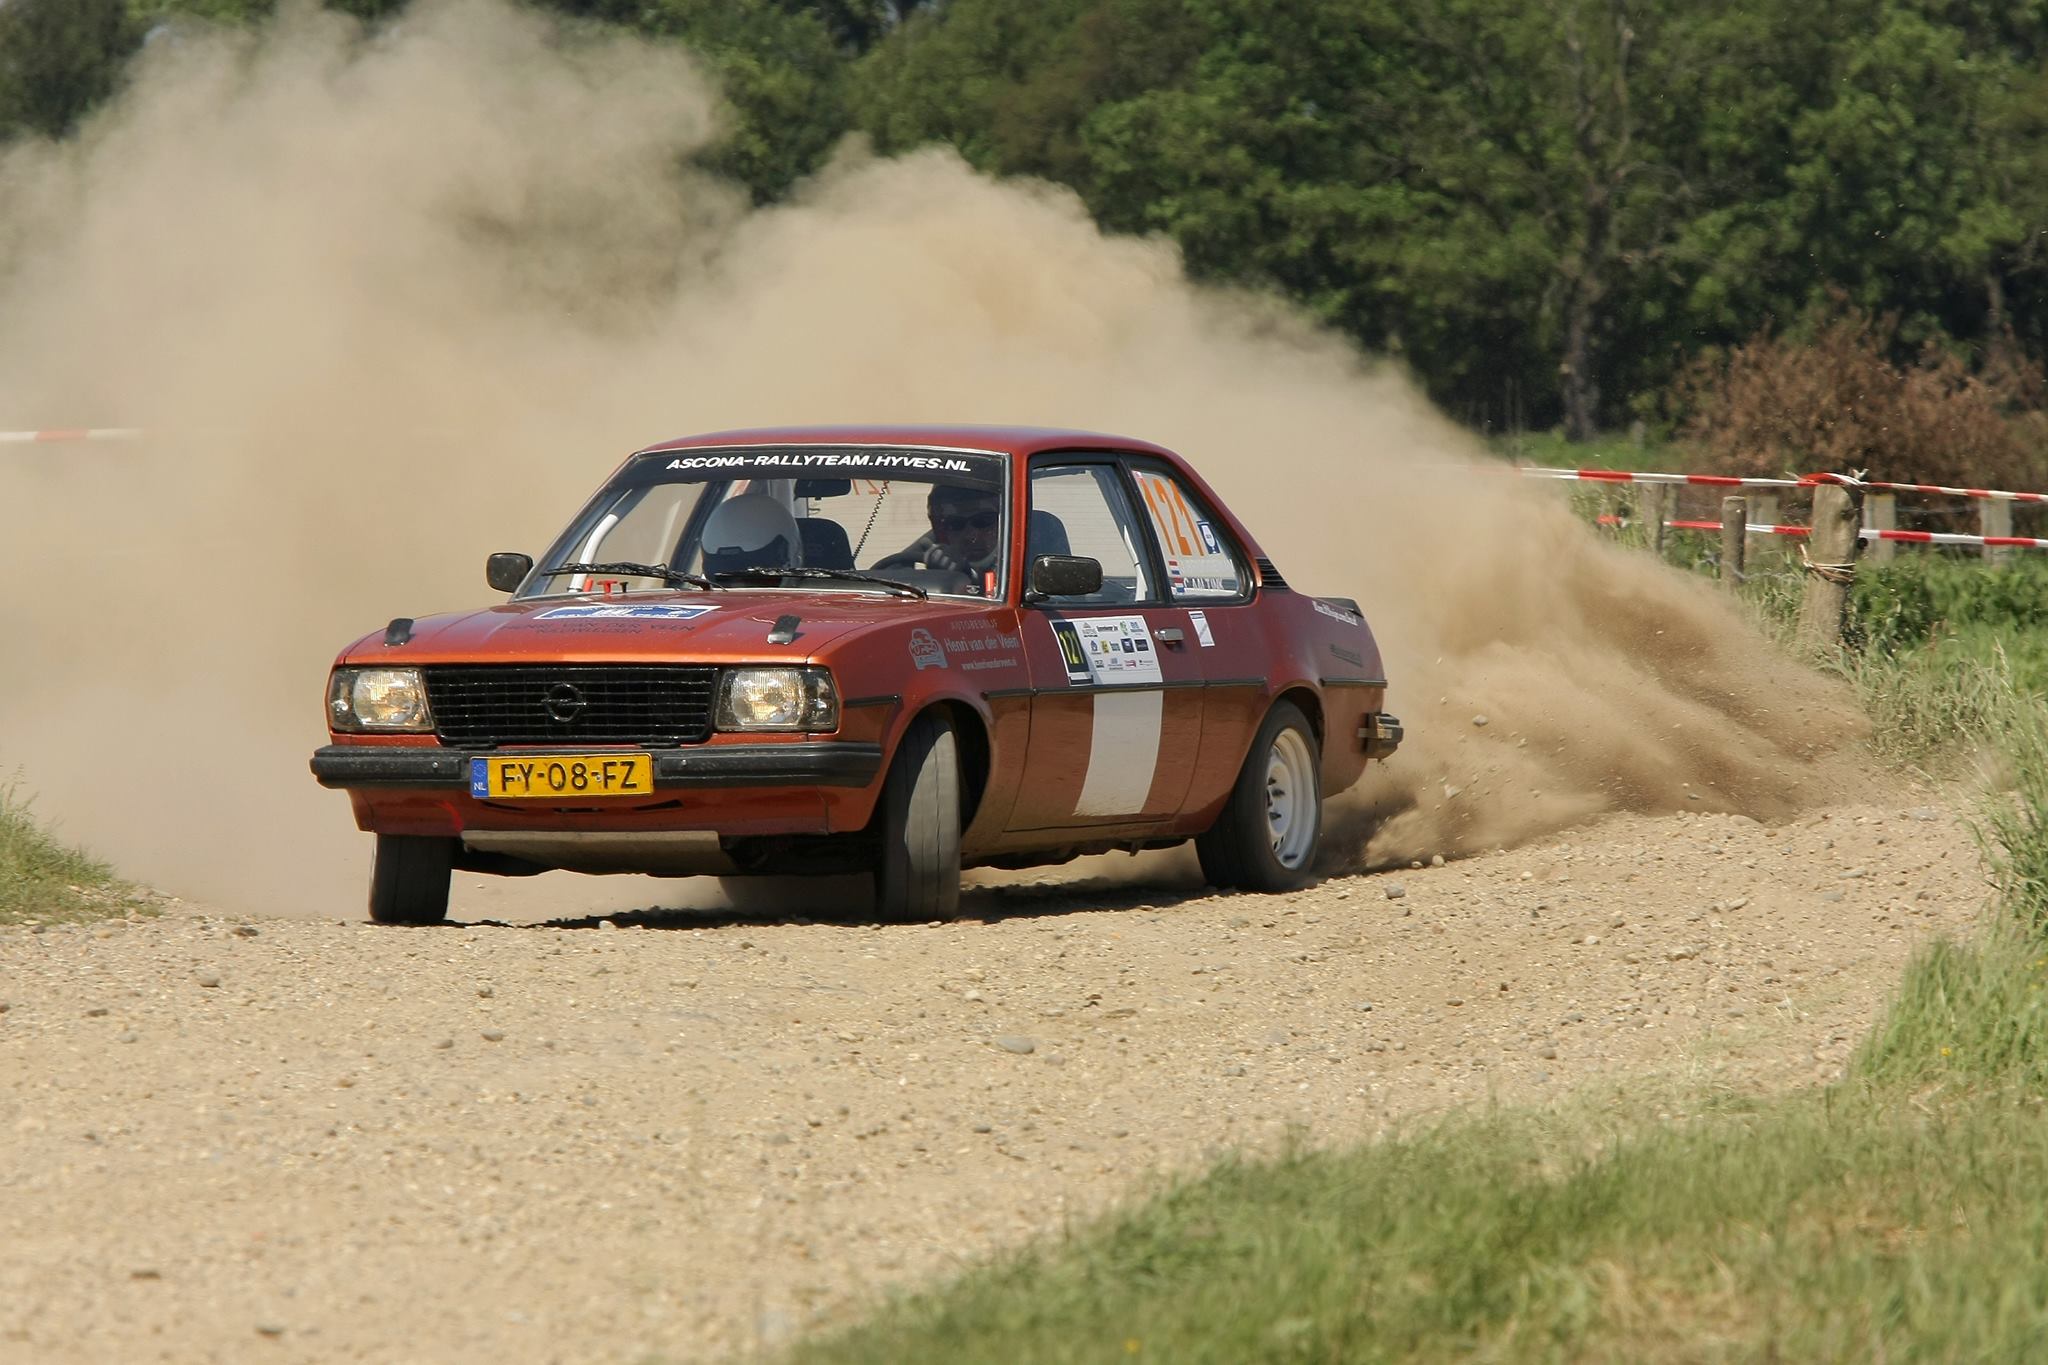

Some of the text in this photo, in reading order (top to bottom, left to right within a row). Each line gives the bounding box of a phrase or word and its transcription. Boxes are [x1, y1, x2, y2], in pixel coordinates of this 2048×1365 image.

[666, 454, 972, 472] ASCONA-RALLYTEAM.HYVES.NL
[1139, 477, 1205, 557] 121
[473, 782, 487, 791] NL
[501, 761, 638, 792] FY-08-FZ
